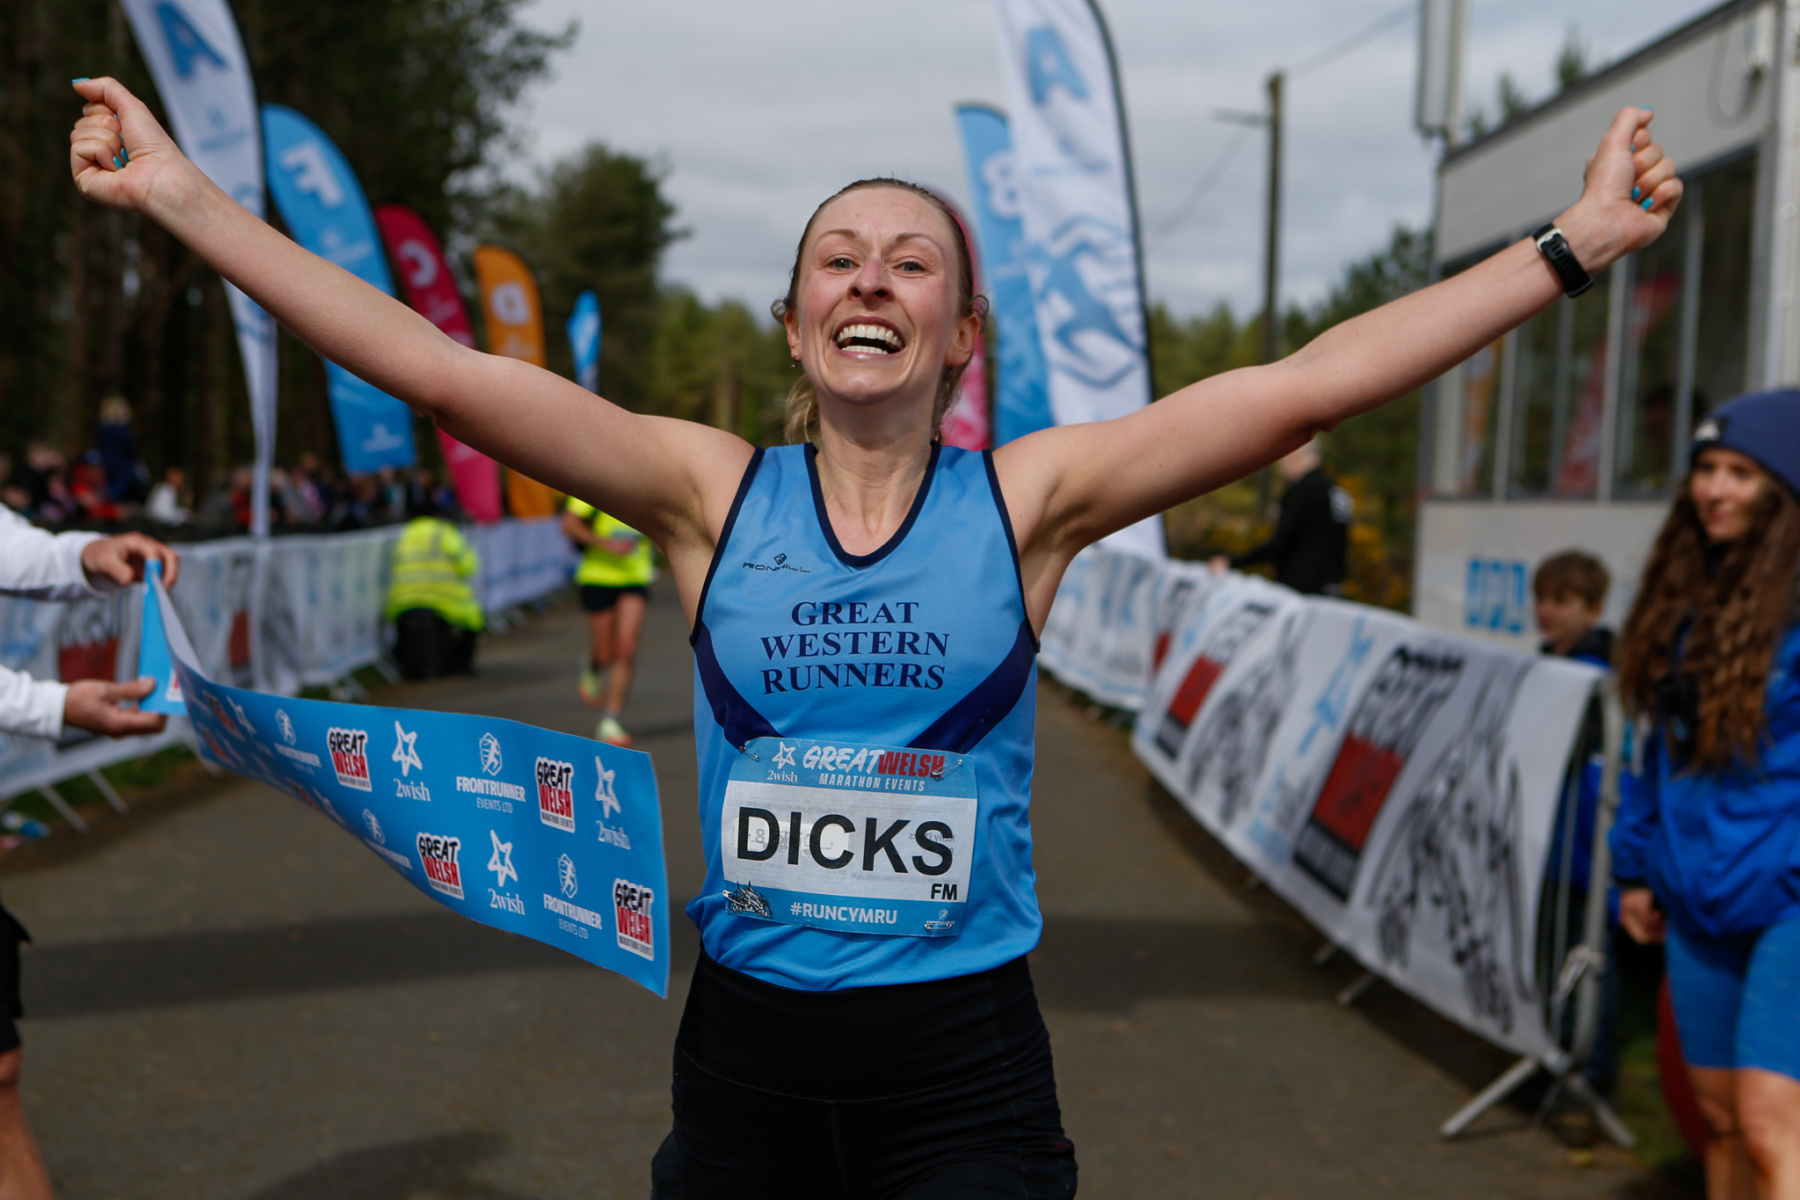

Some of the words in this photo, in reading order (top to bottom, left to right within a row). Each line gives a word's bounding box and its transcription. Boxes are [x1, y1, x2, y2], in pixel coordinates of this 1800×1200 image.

[791, 601, 919, 626] GREAT
[760, 631, 951, 660] WESTERN
[760, 662, 946, 695] RUNNERS
[329, 731, 366, 755] GREAT
[331, 751, 368, 779] WELSH
[537, 761, 572, 791] GREAT
[766, 769, 798, 783] 2wish
[393, 777, 431, 802] 2wish
[456, 776, 526, 803] FRONTRUNNER
[818, 772, 880, 789] MARATHON
[884, 777, 925, 792] EVENTS
[476, 797, 502, 812] EVENTS
[502, 801, 514, 814] LTD
[538, 783, 573, 818] WELSH
[595, 819, 632, 850] 2wish
[737, 806, 954, 876] DICKS
[418, 836, 458, 863] GREAT
[422, 856, 460, 887] WELSH
[488, 888, 526, 915] 2wish
[930, 882, 958, 900] FM
[543, 893, 603, 930] FRONTRUNNER
[789, 901, 898, 924] #RUNCYMRU
